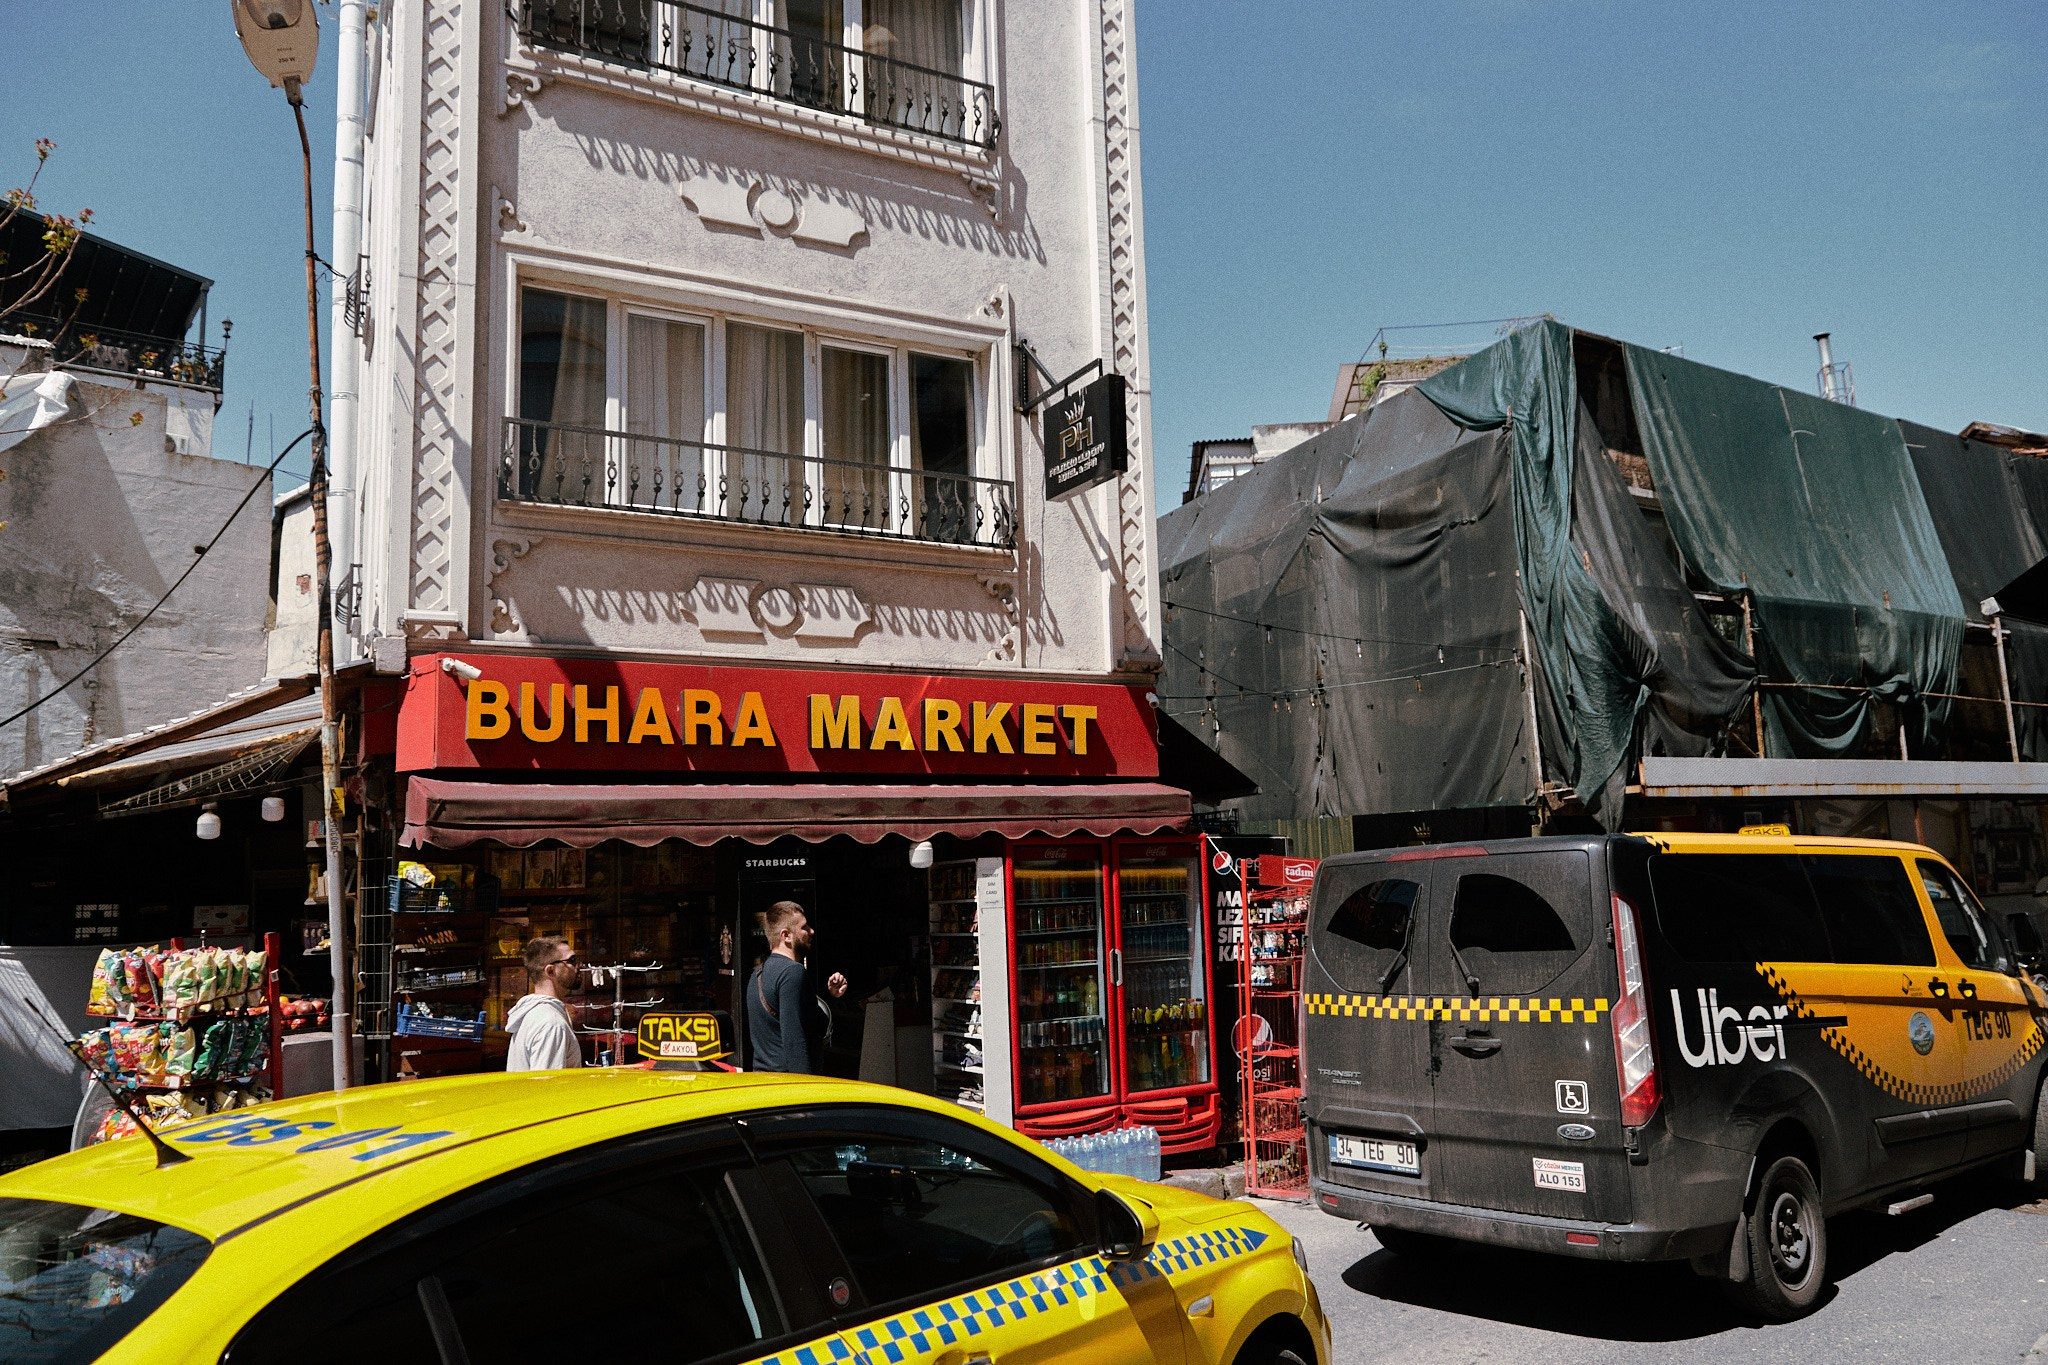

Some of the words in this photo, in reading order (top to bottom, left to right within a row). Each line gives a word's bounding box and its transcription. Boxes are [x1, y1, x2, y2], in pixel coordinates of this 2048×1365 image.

[1059, 415, 1094, 460] PH
[1058, 467, 1079, 484] HOTEL
[1083, 457, 1098, 472] SPA
[465, 680, 776, 748] BUHARA
[808, 693, 1098, 756] MARKET
[745, 858, 806, 867] STARBUCKS
[1285, 866, 1314, 878] tadım
[1217, 907, 1273, 925] LEZET
[1670, 987, 1788, 1068] Uber
[1962, 1010, 1993, 1041] TEG
[1994, 1009, 2011, 1040] 90
[671, 1044, 695, 1054] AKYOL
[1318, 1068, 1361, 1078] TRANSIT
[1332, 1078, 1361, 1086] CUSTOM
[1564, 1126, 1586, 1137] Ford
[1337, 1136, 1353, 1158] 34
[1360, 1139, 1385, 1162] TEG
[1397, 1143, 1415, 1166] 90
[1539, 1173, 1560, 1185] ALO
[1562, 1175, 1581, 1187] 153
